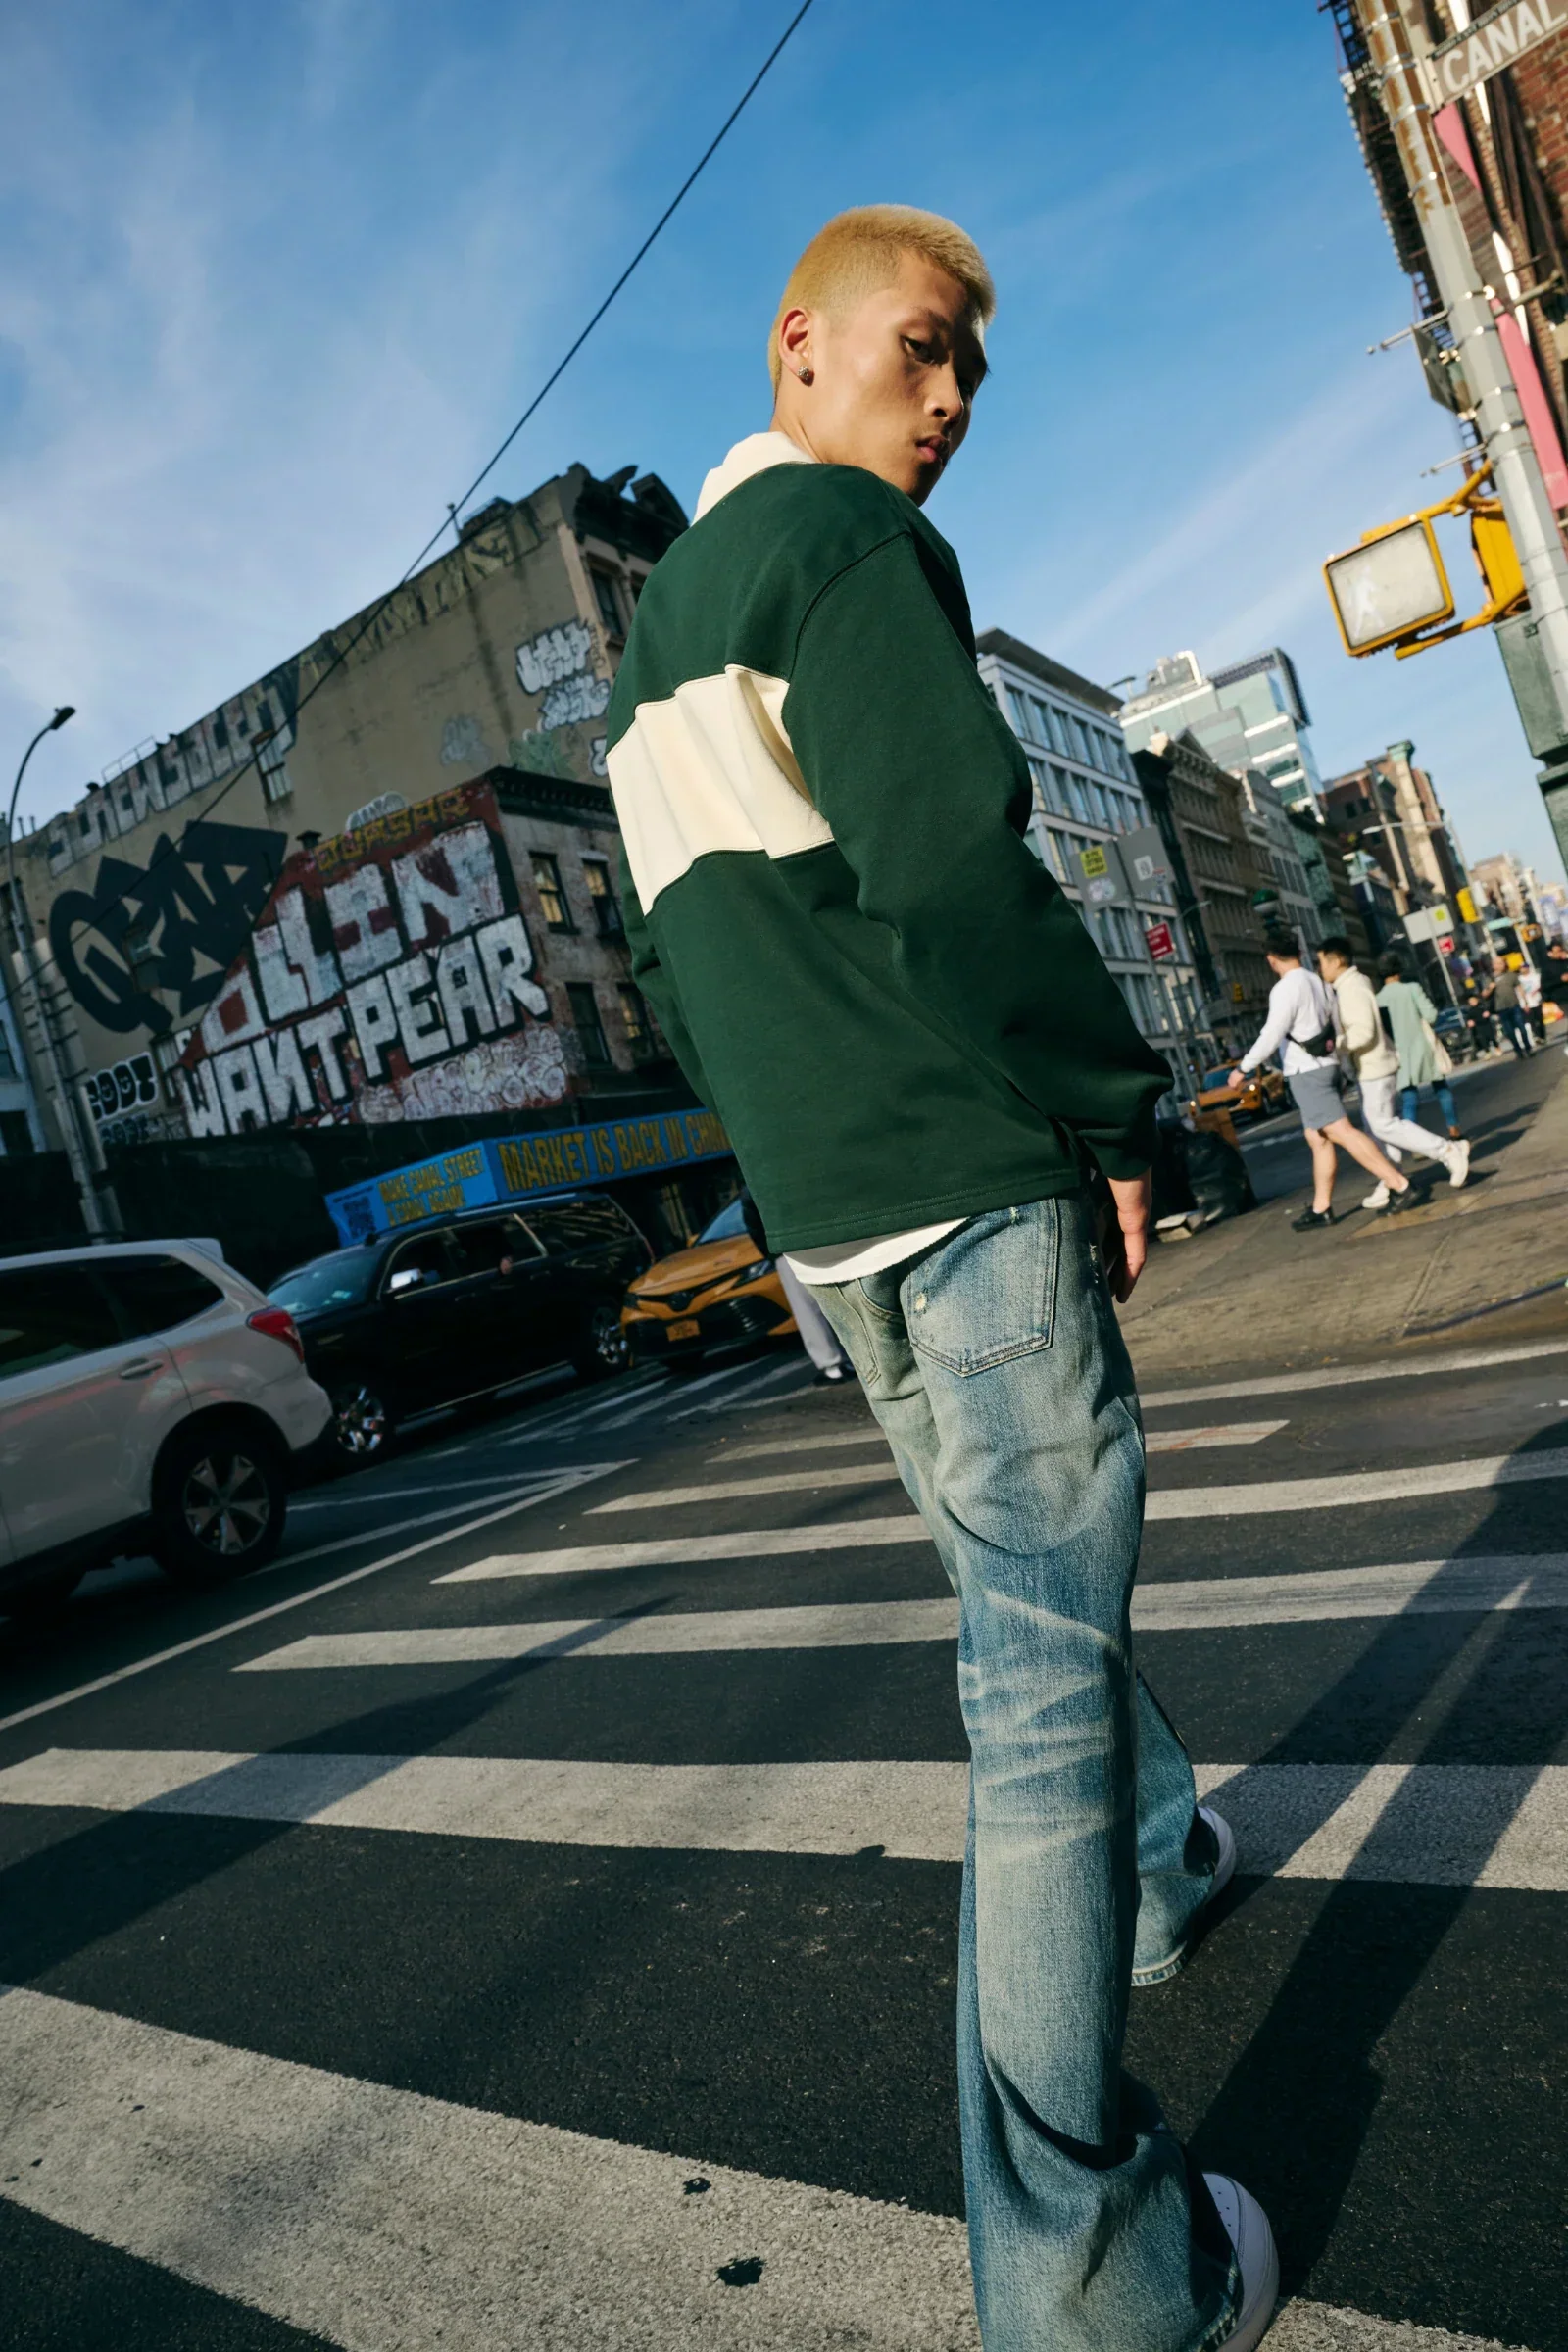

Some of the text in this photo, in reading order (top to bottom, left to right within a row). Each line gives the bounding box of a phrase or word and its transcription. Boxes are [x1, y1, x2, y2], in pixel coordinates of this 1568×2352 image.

[1443, 0, 1567, 93] CANAL
[346, 913, 550, 1079] PEAR
[408, 1163, 445, 1195] CANAL
[444, 1149, 484, 1183] STREET
[498, 1133, 591, 1192] MARKET
[591, 1128, 616, 1175] IS
[613, 1121, 667, 1171] BACK
